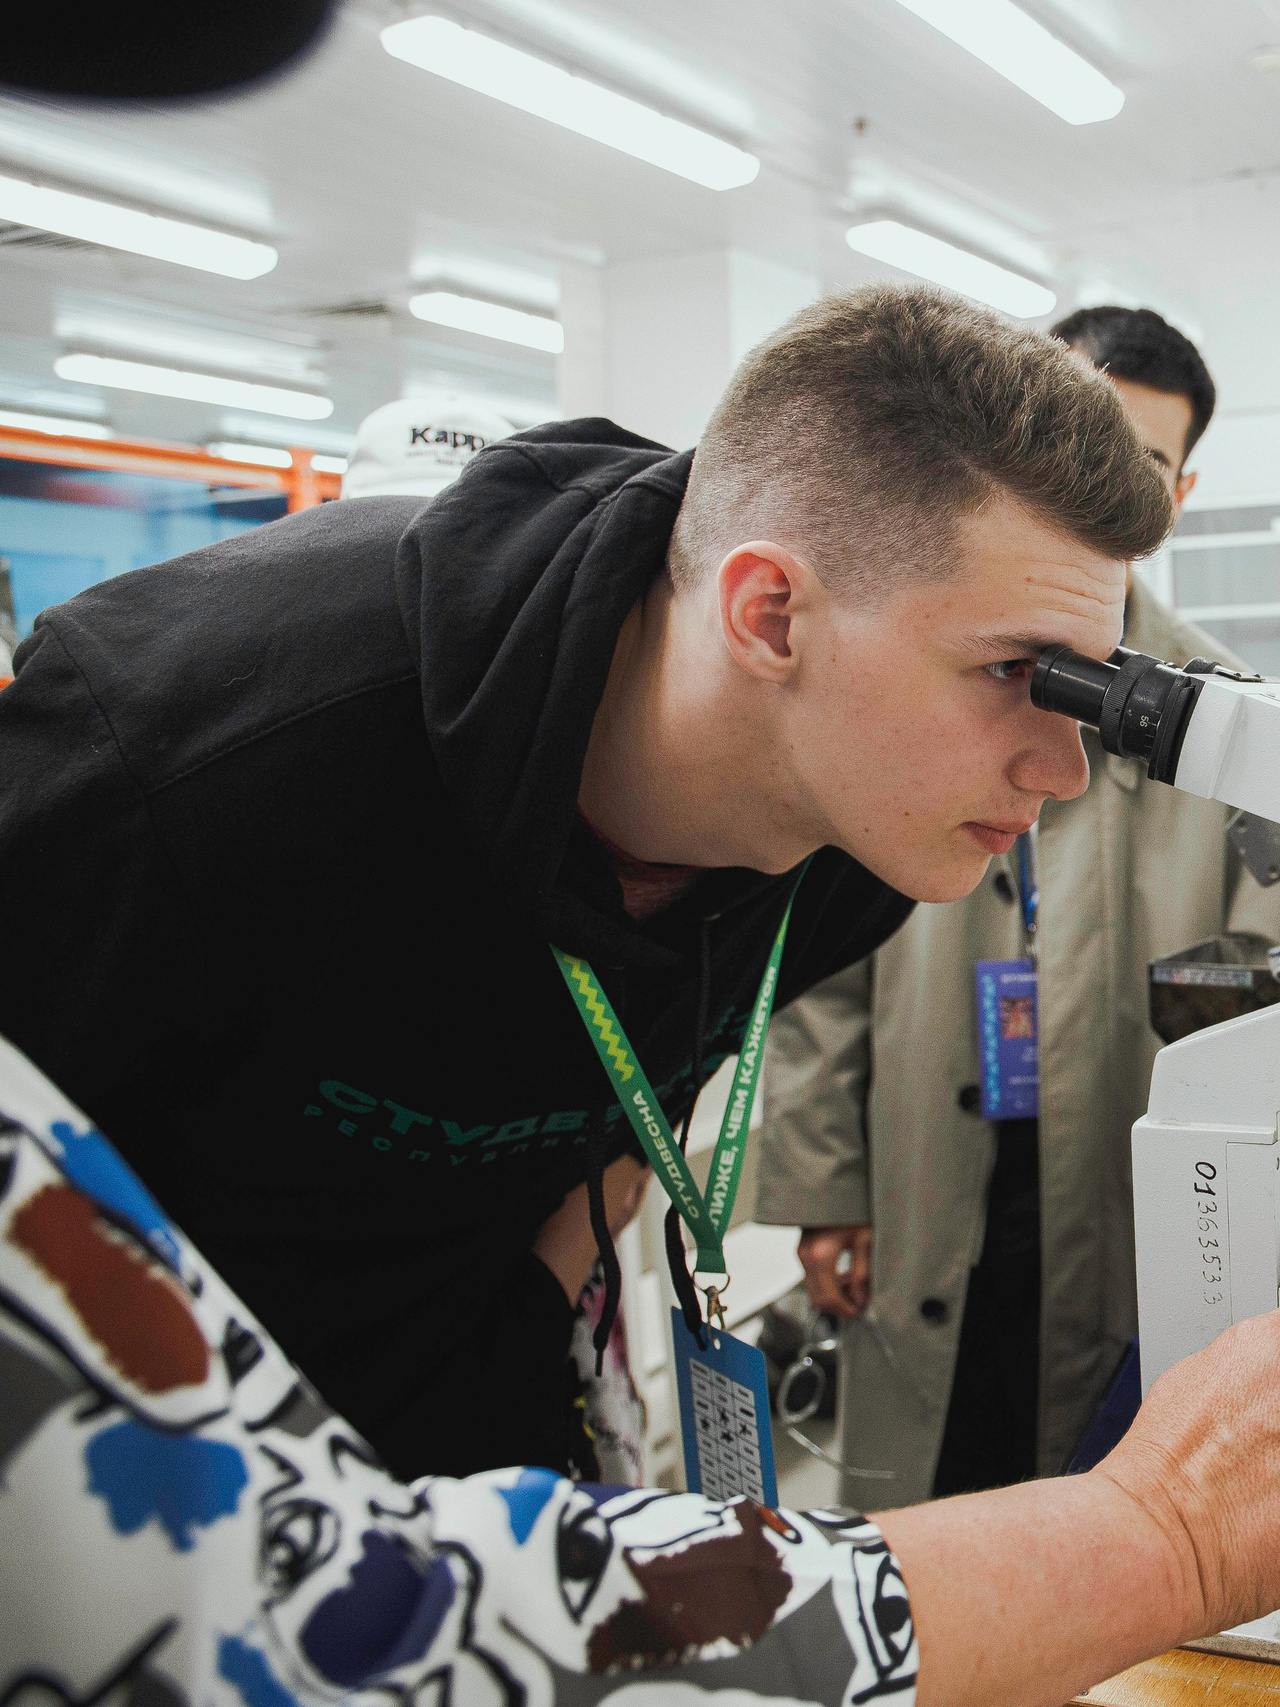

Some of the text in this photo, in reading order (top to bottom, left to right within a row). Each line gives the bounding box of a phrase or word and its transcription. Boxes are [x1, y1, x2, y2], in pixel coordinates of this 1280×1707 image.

[411, 427, 488, 451] Kapp
[632, 1089, 699, 1219] СТУДВЕСНА
[708, 965, 777, 1226] ЛИЖЕ, ЧЕМ КАЖЕТСЯ
